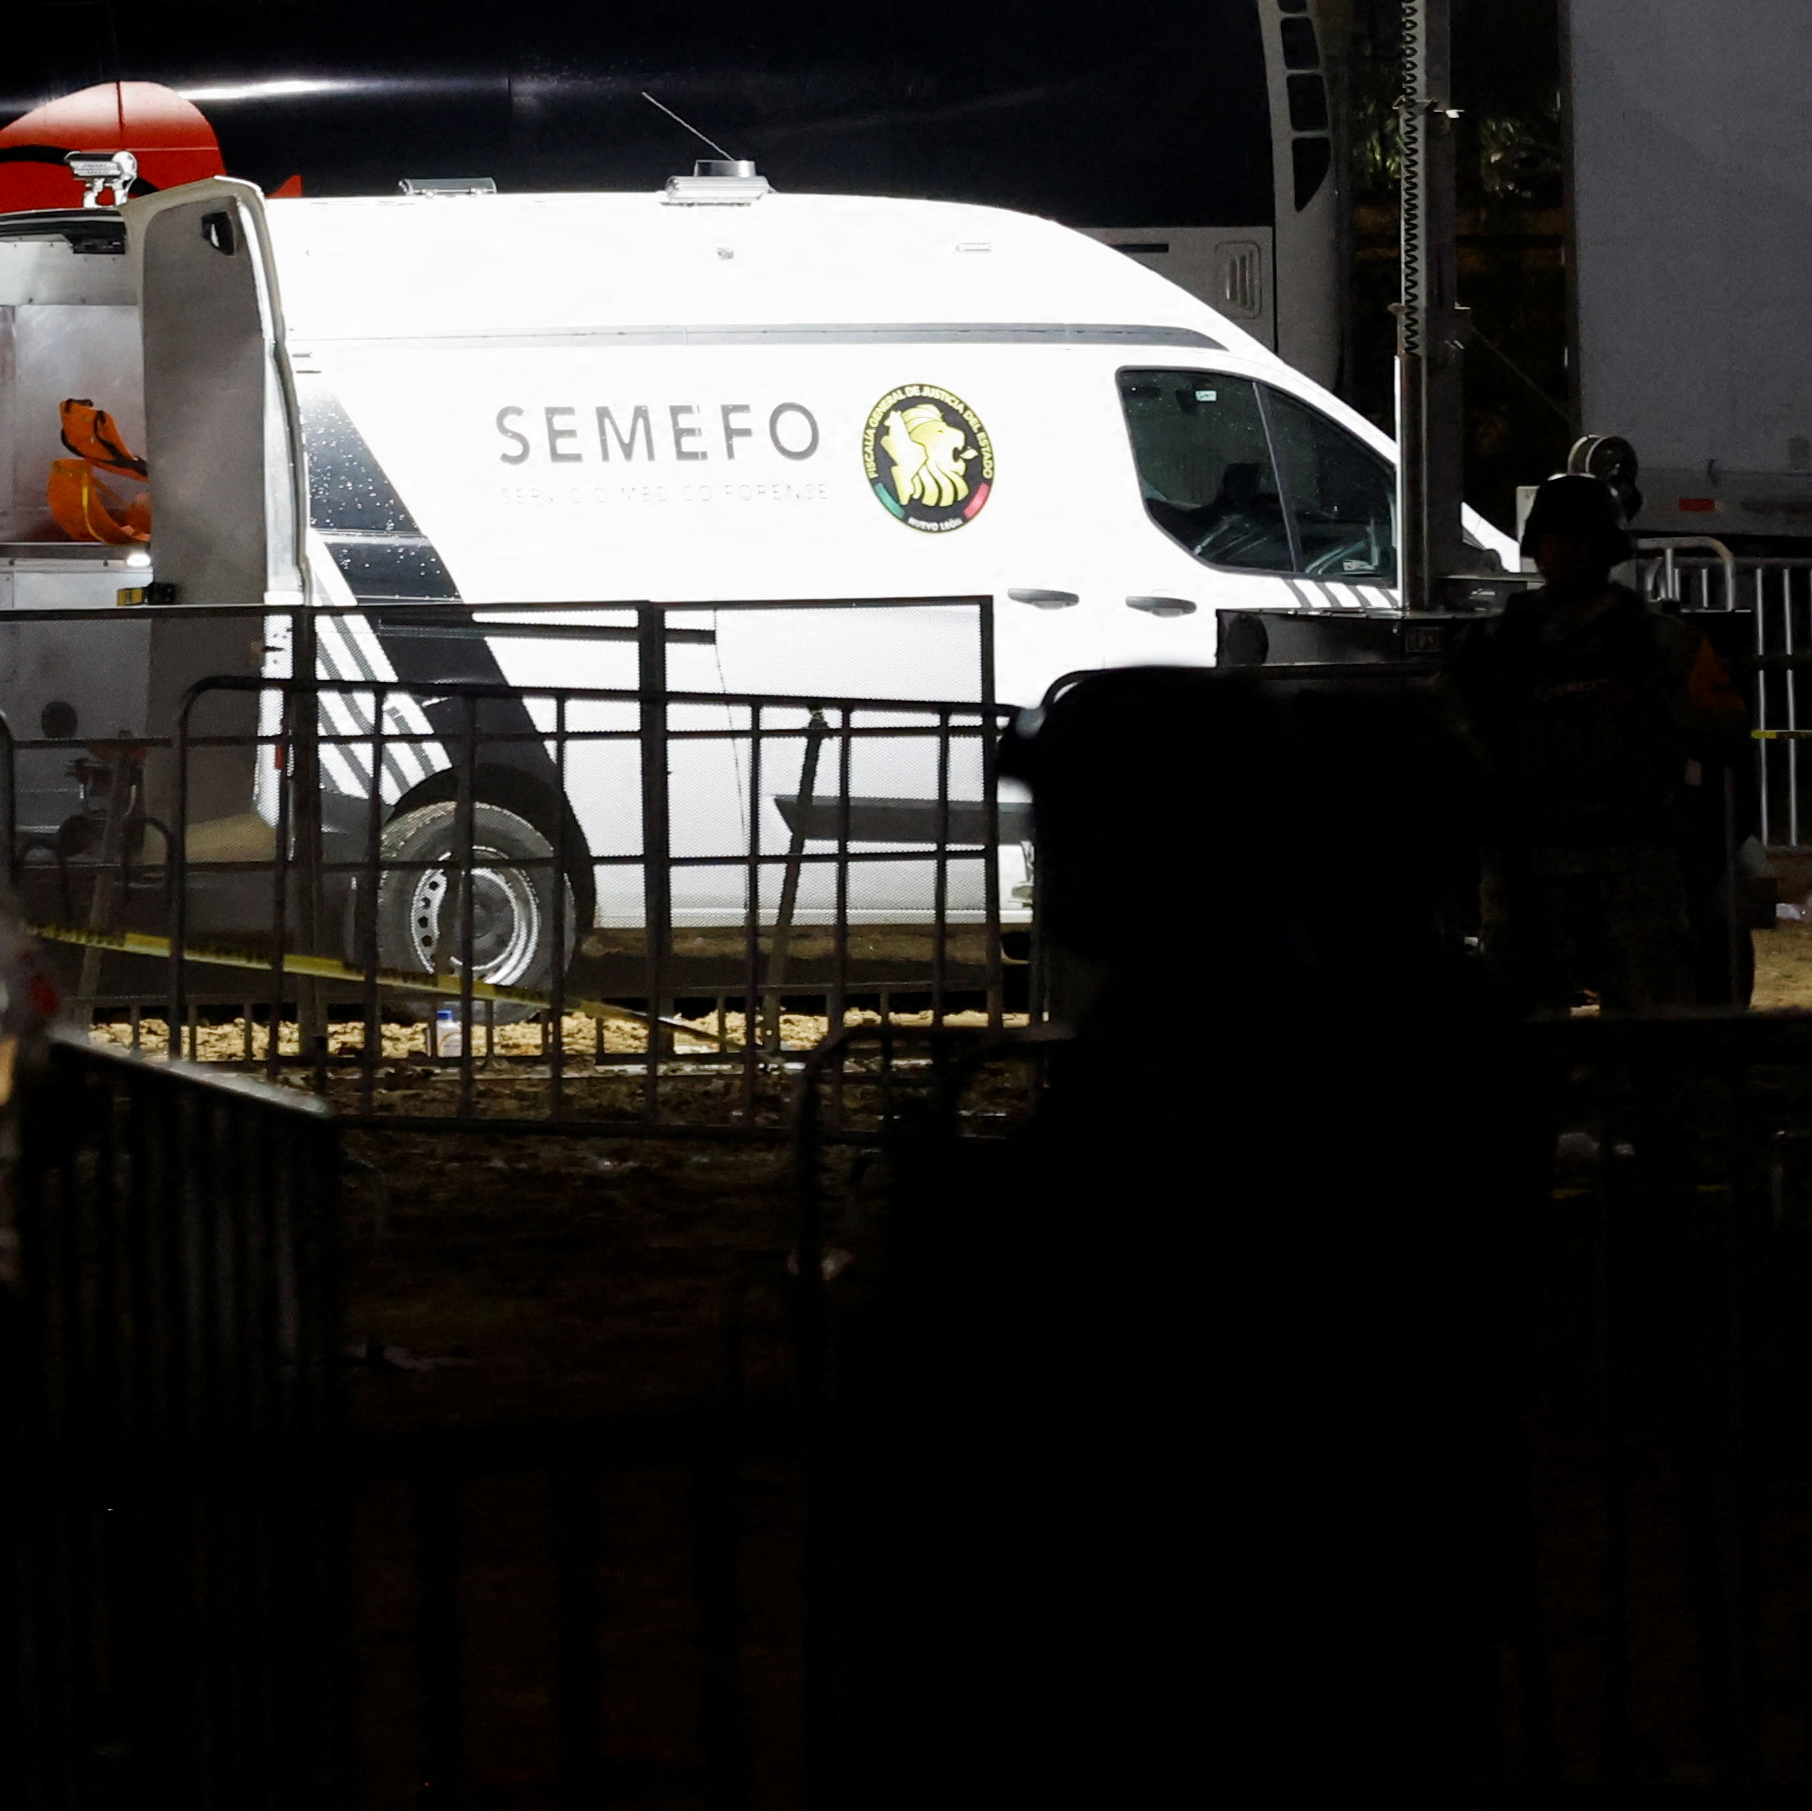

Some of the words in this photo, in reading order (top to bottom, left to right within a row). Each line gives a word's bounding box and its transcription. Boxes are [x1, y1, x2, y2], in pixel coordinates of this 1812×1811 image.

[494, 400, 821, 465] SEMEFO
[868, 388, 906, 428] GENERAL
[904, 385, 921, 397] DE
[921, 385, 965, 414] JUSTICIA
[963, 409, 983, 434] DEL
[976, 432, 993, 479] ESTADO
